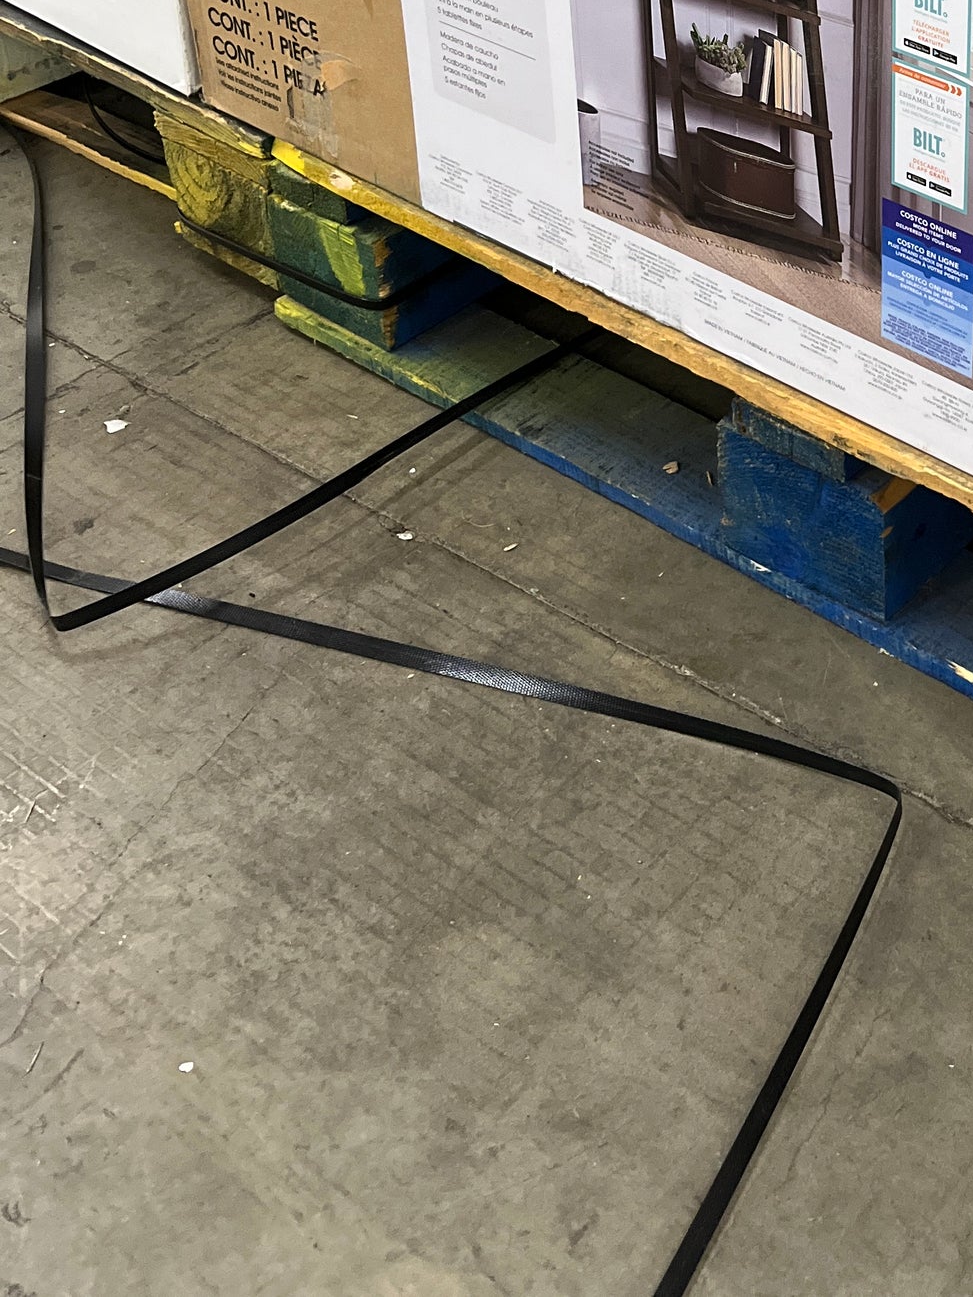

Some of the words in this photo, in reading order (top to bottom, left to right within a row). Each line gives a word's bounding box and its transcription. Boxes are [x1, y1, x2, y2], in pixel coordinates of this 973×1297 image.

[207, 6, 257, 43] CONT.
[267, 30, 276, 51] 1
[263, 1, 271, 22] 1
[275, 6, 320, 42] PIECE
[212, 35, 261, 72] CONT.
[271, 60, 279, 80] 1
[900, 209, 928, 228] COSTCO
[930, 221, 957, 240] ONLINE
[896, 237, 925, 256] COSTCO
[926, 250, 936, 261] EN
[938, 255, 960, 270] LIGNE
